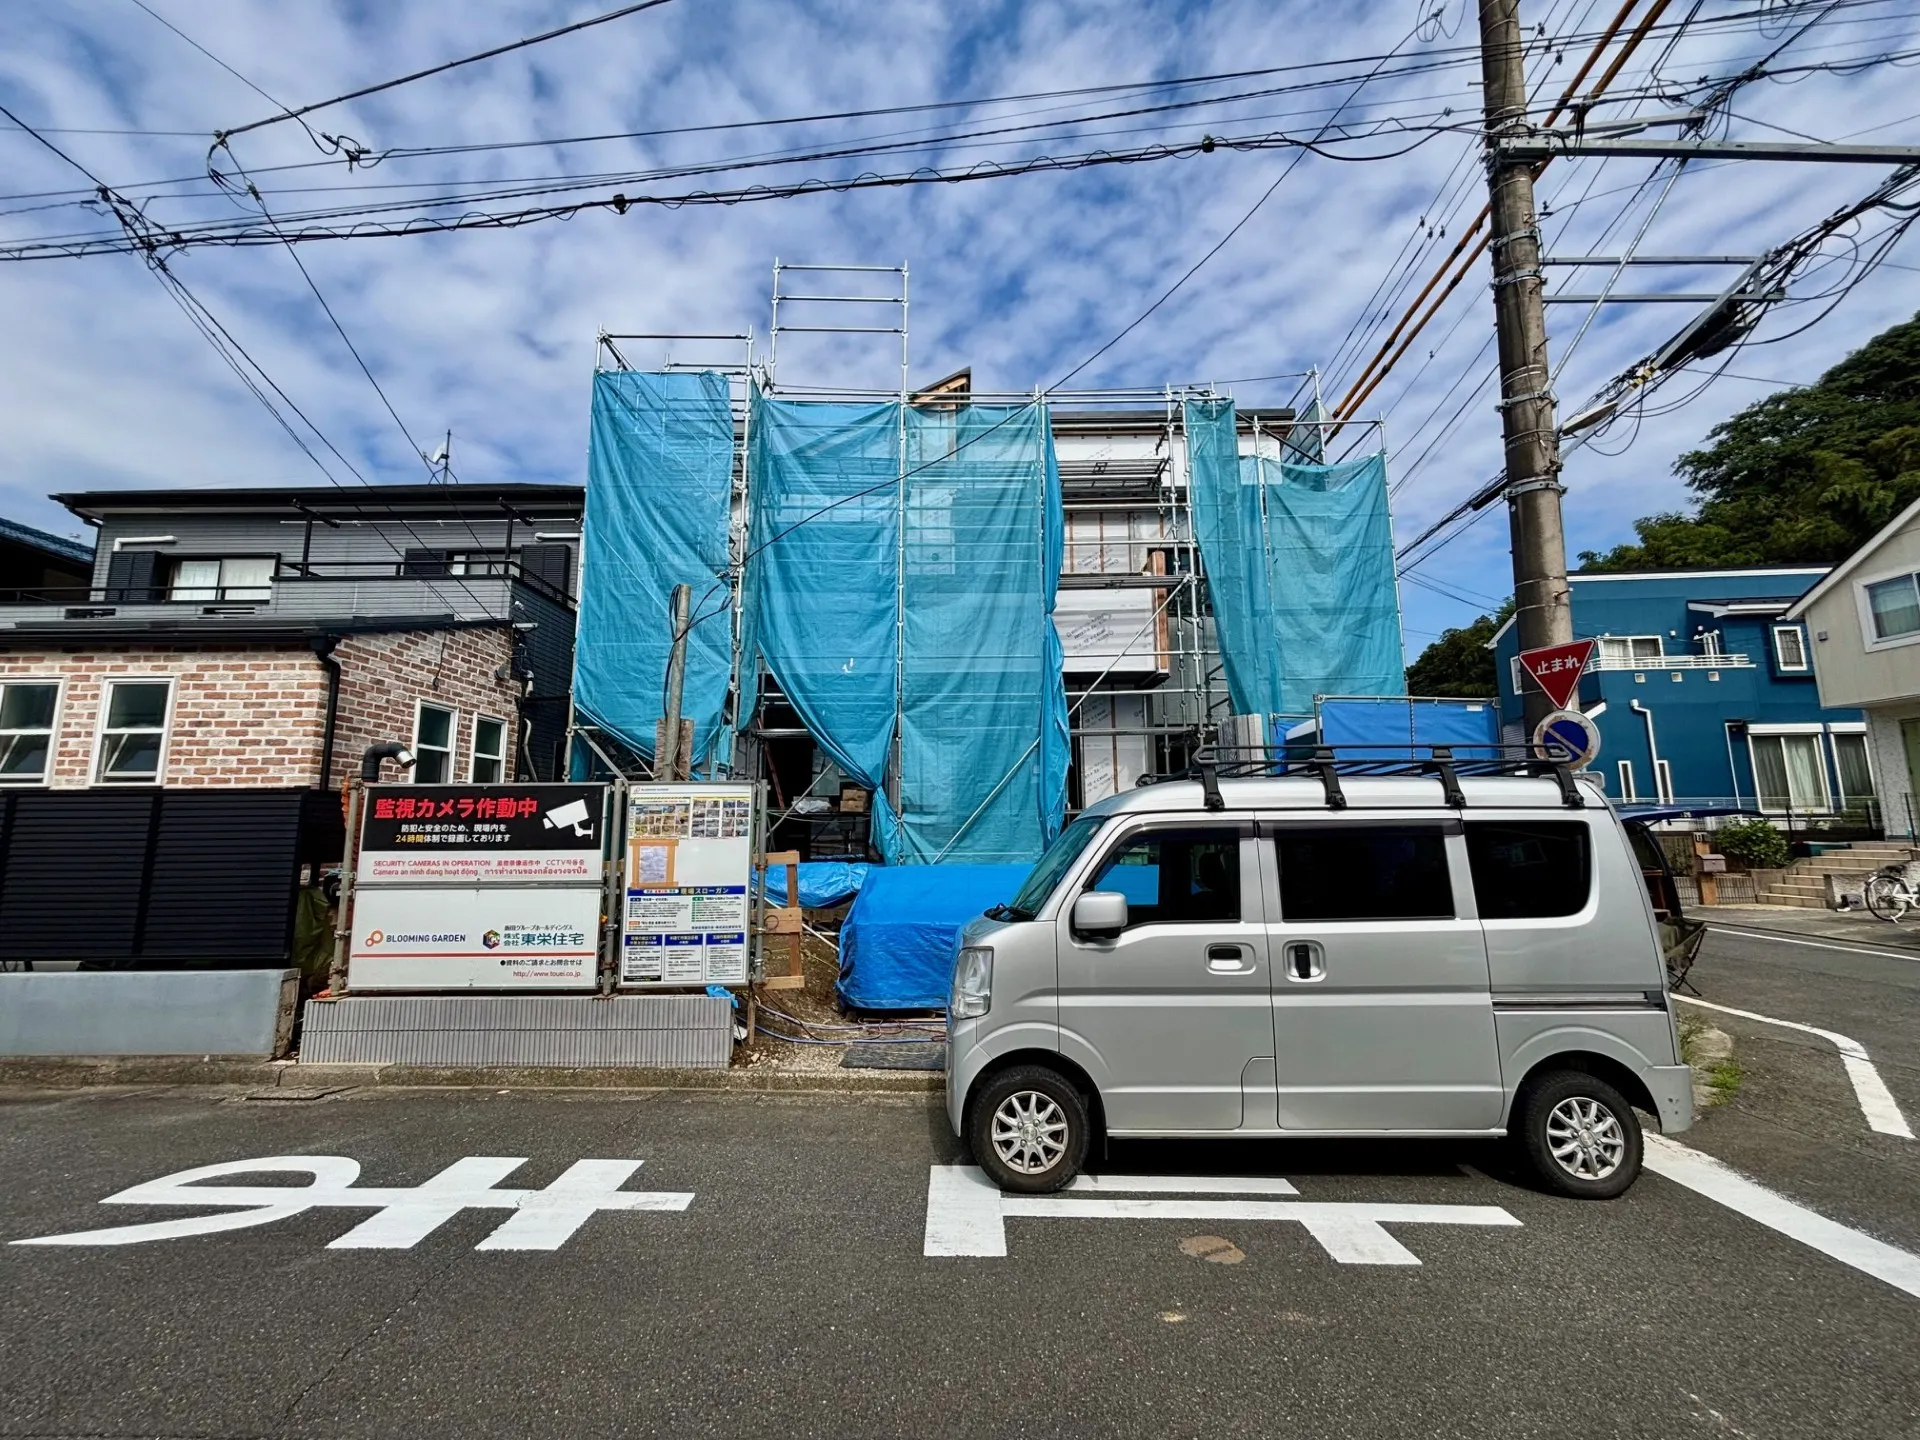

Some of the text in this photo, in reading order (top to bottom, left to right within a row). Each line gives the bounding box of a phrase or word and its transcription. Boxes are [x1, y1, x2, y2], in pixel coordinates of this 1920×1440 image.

[1536, 655, 1581, 676] 止まれ
[374, 797, 538, 819] 監視カメラ作動中
[401, 823, 507, 833] 防犯と安全のため、現場内を
[395, 833, 511, 843] 24時間体制で録画しております
[386, 934, 466, 943] BLOOMING GARDEN
[520, 932, 585, 946] 東栄住宅
